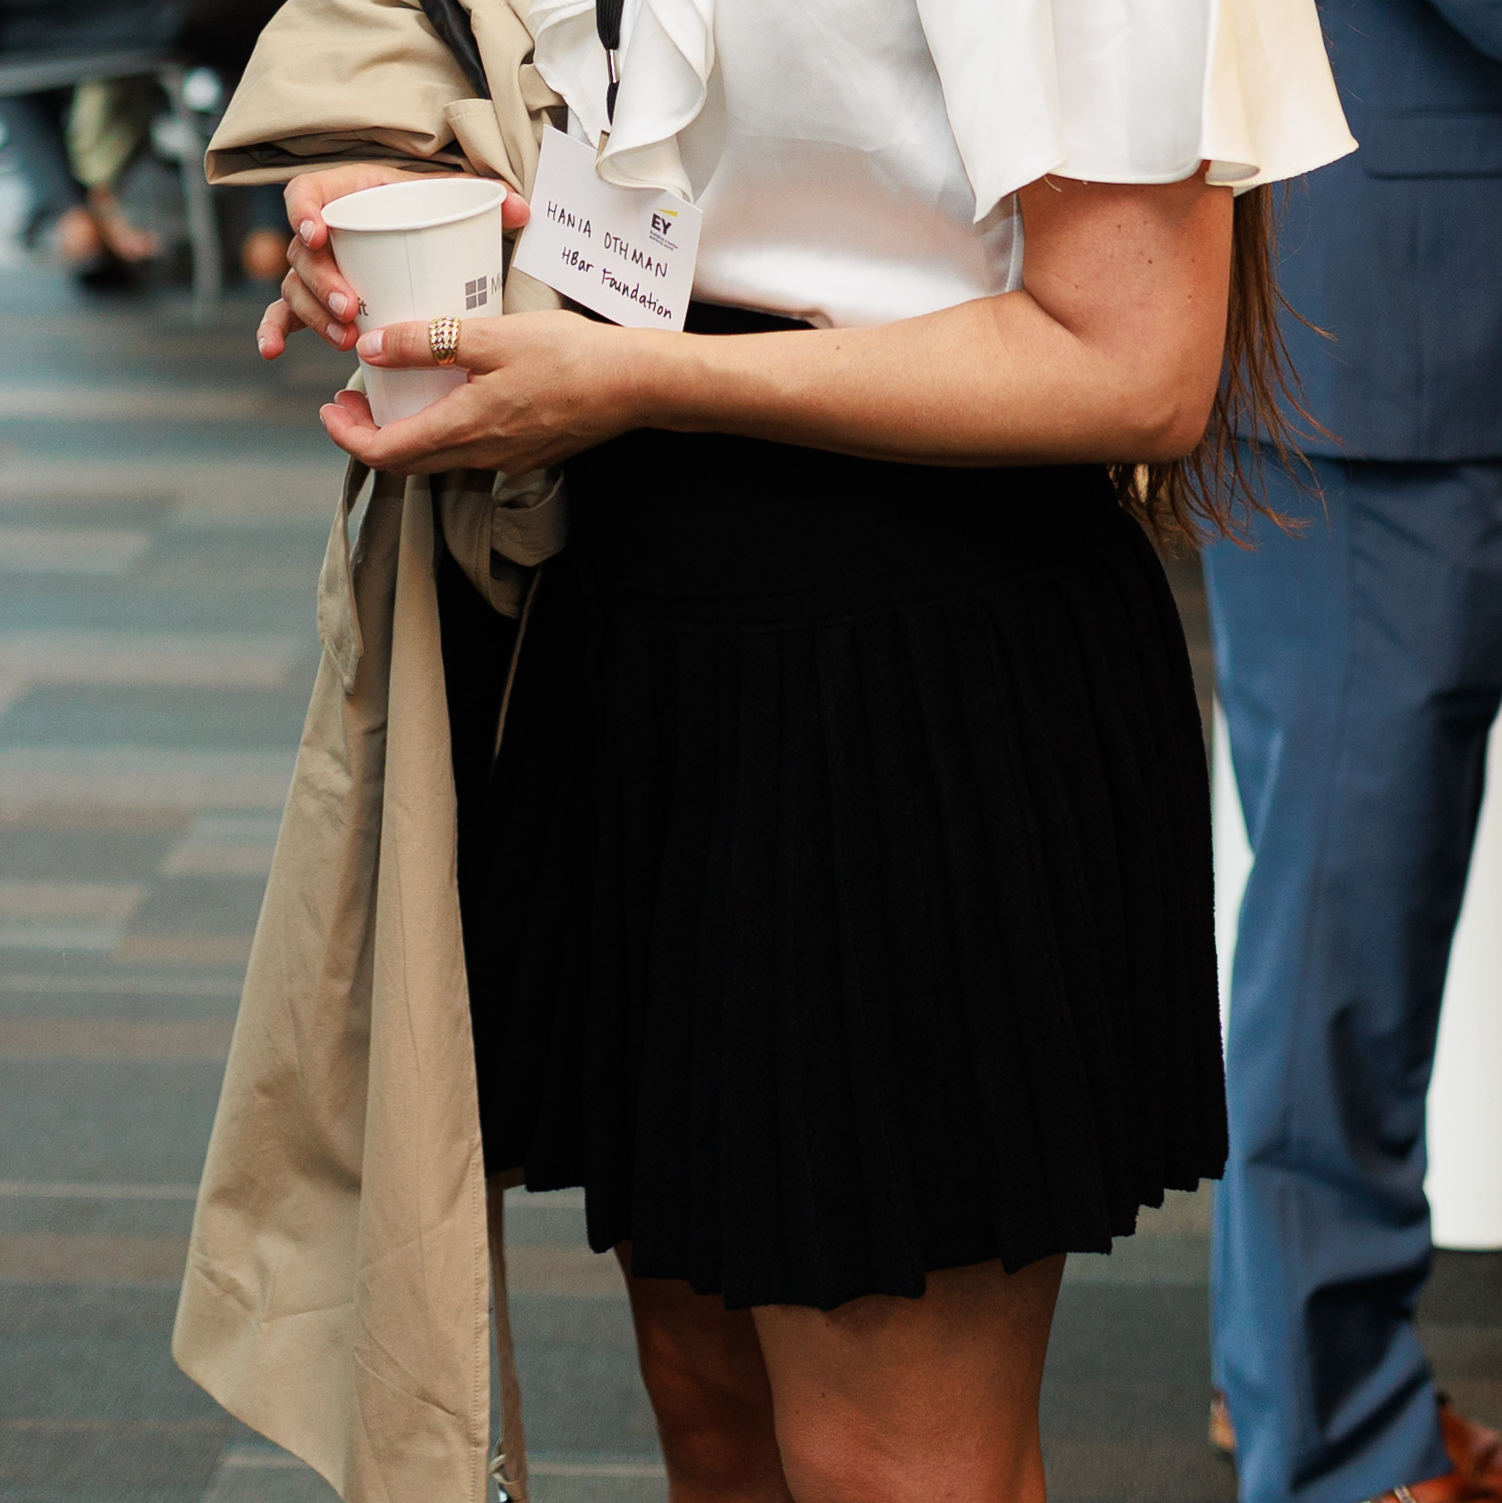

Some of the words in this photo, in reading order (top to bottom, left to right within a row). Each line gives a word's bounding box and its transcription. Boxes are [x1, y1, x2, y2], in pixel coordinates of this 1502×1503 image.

[547, 200, 592, 238] HANIA
[604, 232, 668, 277] OTHMAN
[651, 212, 672, 235] EY
